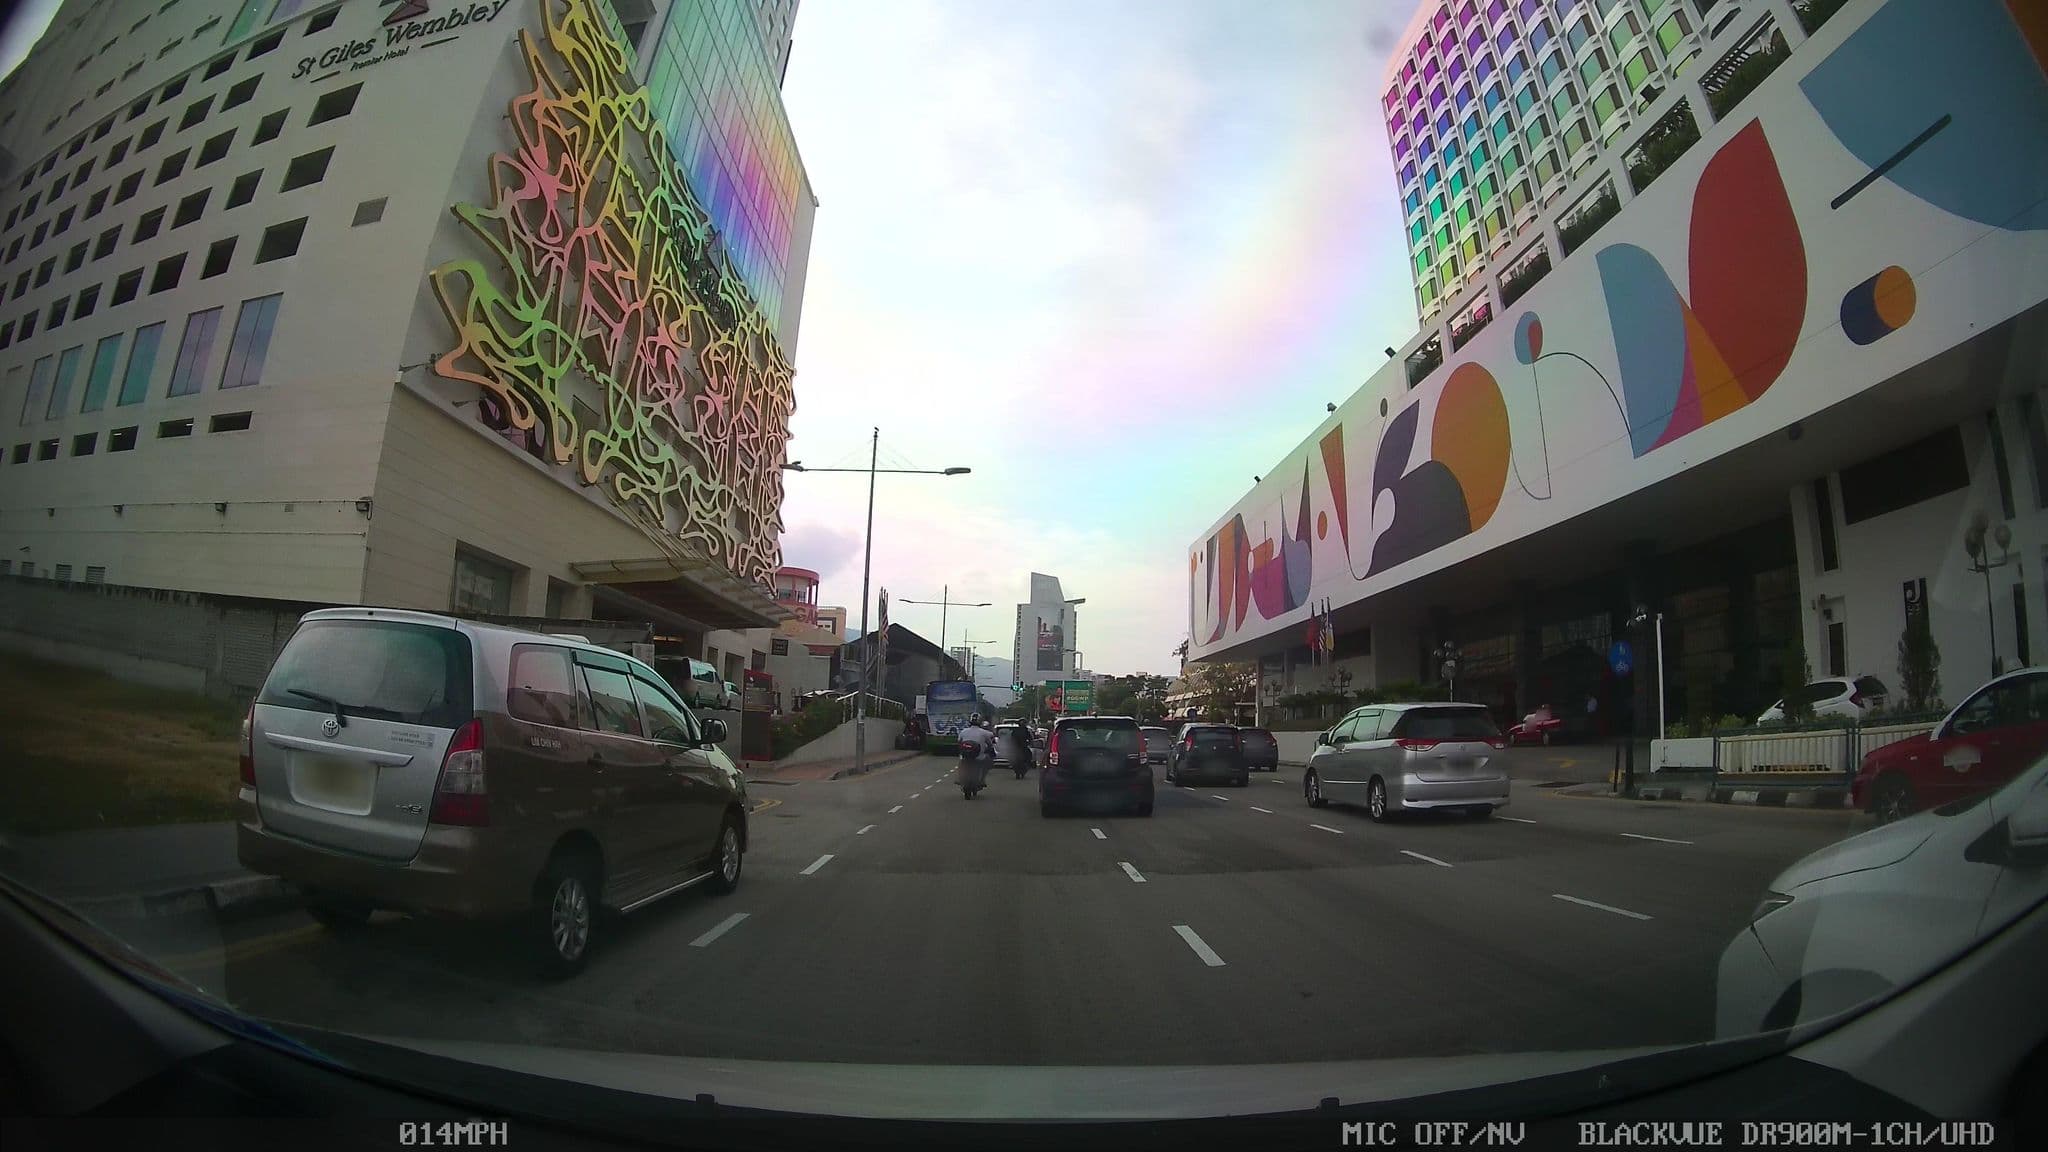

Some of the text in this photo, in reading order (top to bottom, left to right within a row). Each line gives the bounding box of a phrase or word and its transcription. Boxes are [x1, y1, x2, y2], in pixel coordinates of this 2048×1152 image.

[291, 0, 509, 79] St Giles Wembley
[350, 45, 410, 71] Premier Hotel
